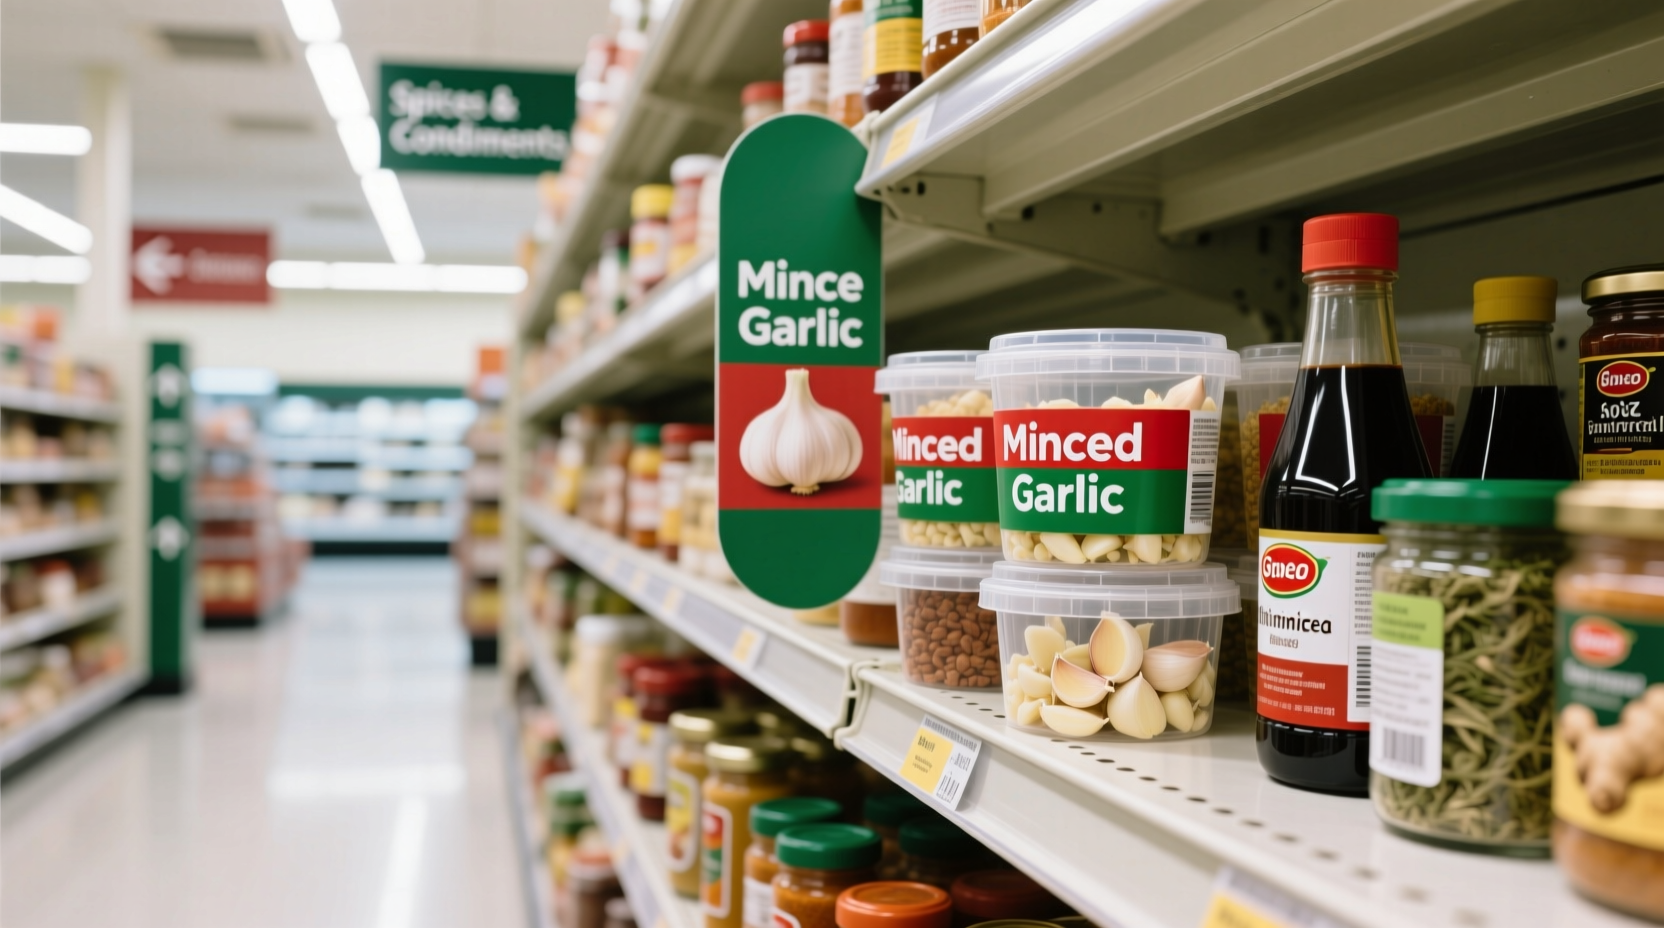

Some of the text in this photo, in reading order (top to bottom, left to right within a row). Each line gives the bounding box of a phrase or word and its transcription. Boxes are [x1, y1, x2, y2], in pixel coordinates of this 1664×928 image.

[389, 80, 521, 126] Spices &
[389, 118, 568, 160] Condiments
[738, 258, 864, 303] Mince
[738, 305, 864, 349] Garlic
[1002, 420, 1143, 462] Minced
[1012, 472, 1125, 515] Garlic
